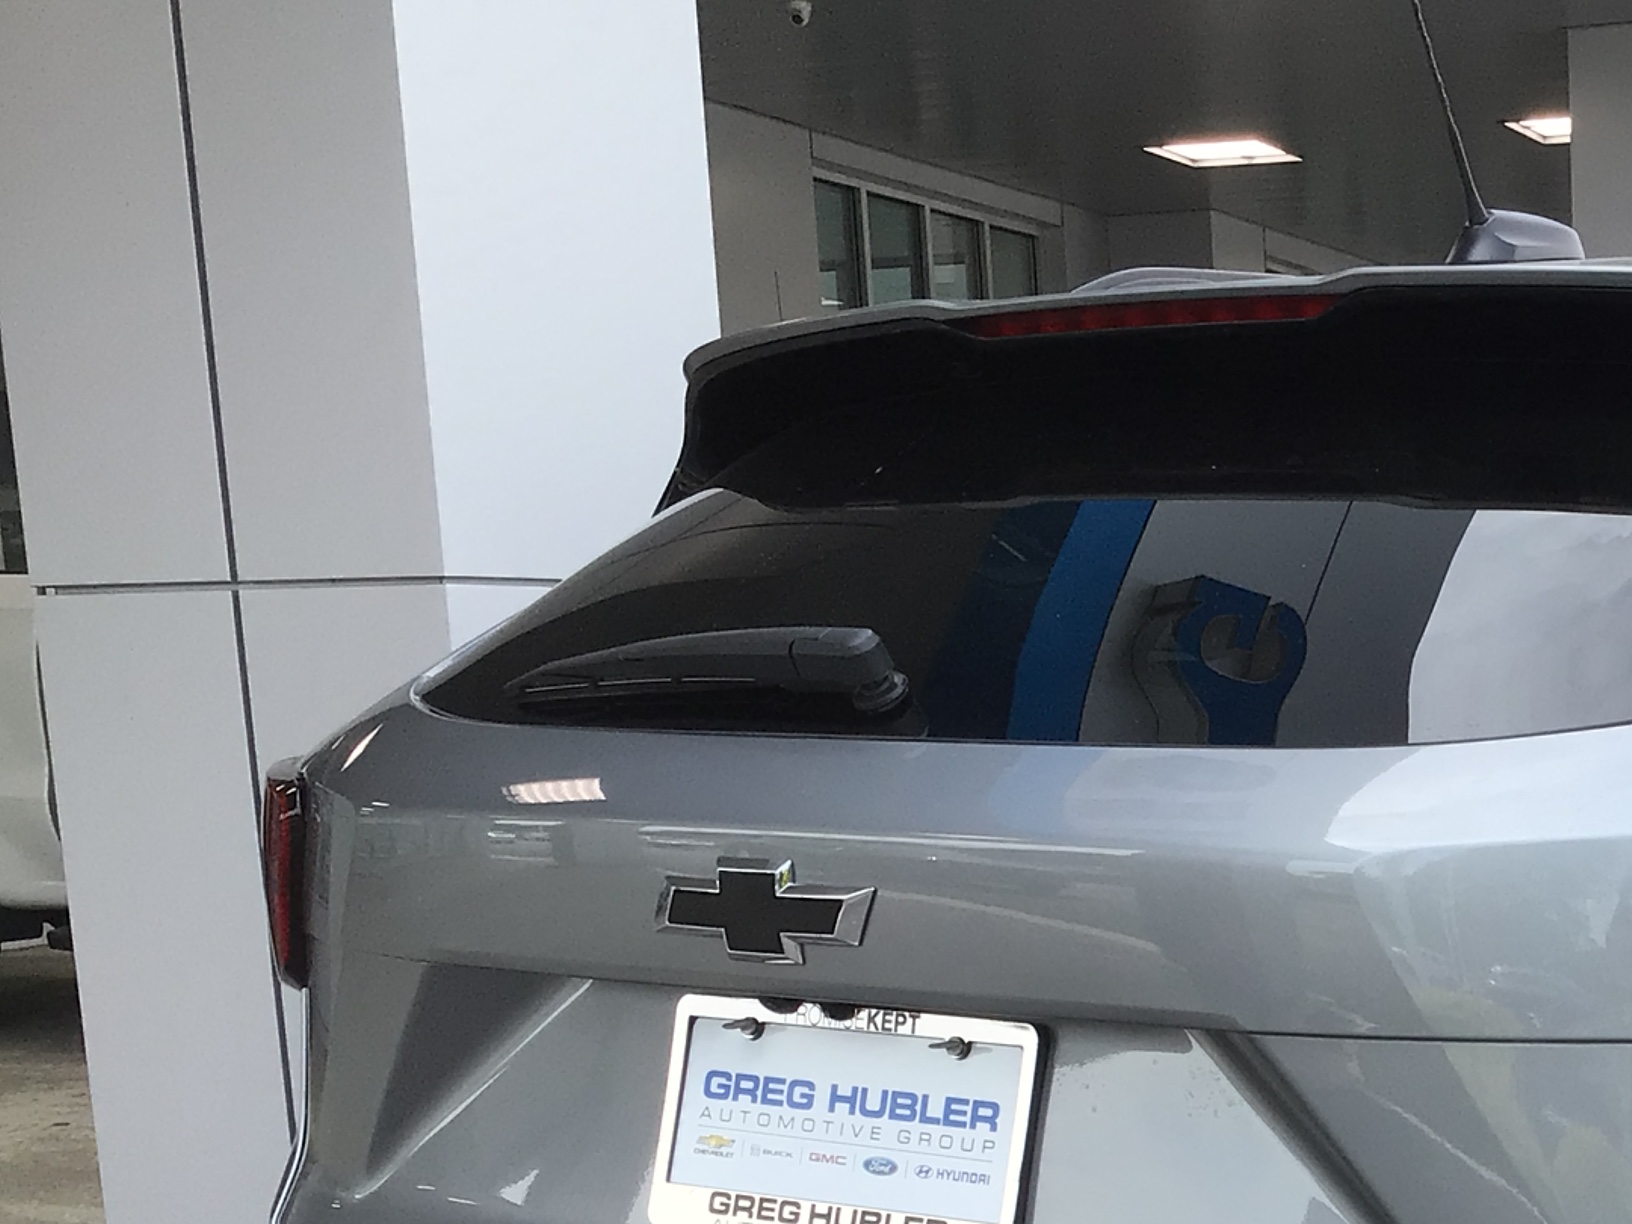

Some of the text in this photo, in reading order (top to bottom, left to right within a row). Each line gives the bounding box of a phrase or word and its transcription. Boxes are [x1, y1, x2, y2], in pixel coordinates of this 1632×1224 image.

[703, 1070, 1000, 1132] GREG HUBLER
[699, 1106, 996, 1153] AUTOMOTIVE GROUP
[693, 1147, 734, 1158] CHEVROLET
[762, 1148, 793, 1159] BUICK
[809, 1152, 848, 1166] GMC
[866, 1157, 895, 1174] Ford
[936, 1168, 991, 1185] HYUNDAI
[708, 1191, 801, 1224] GREG
